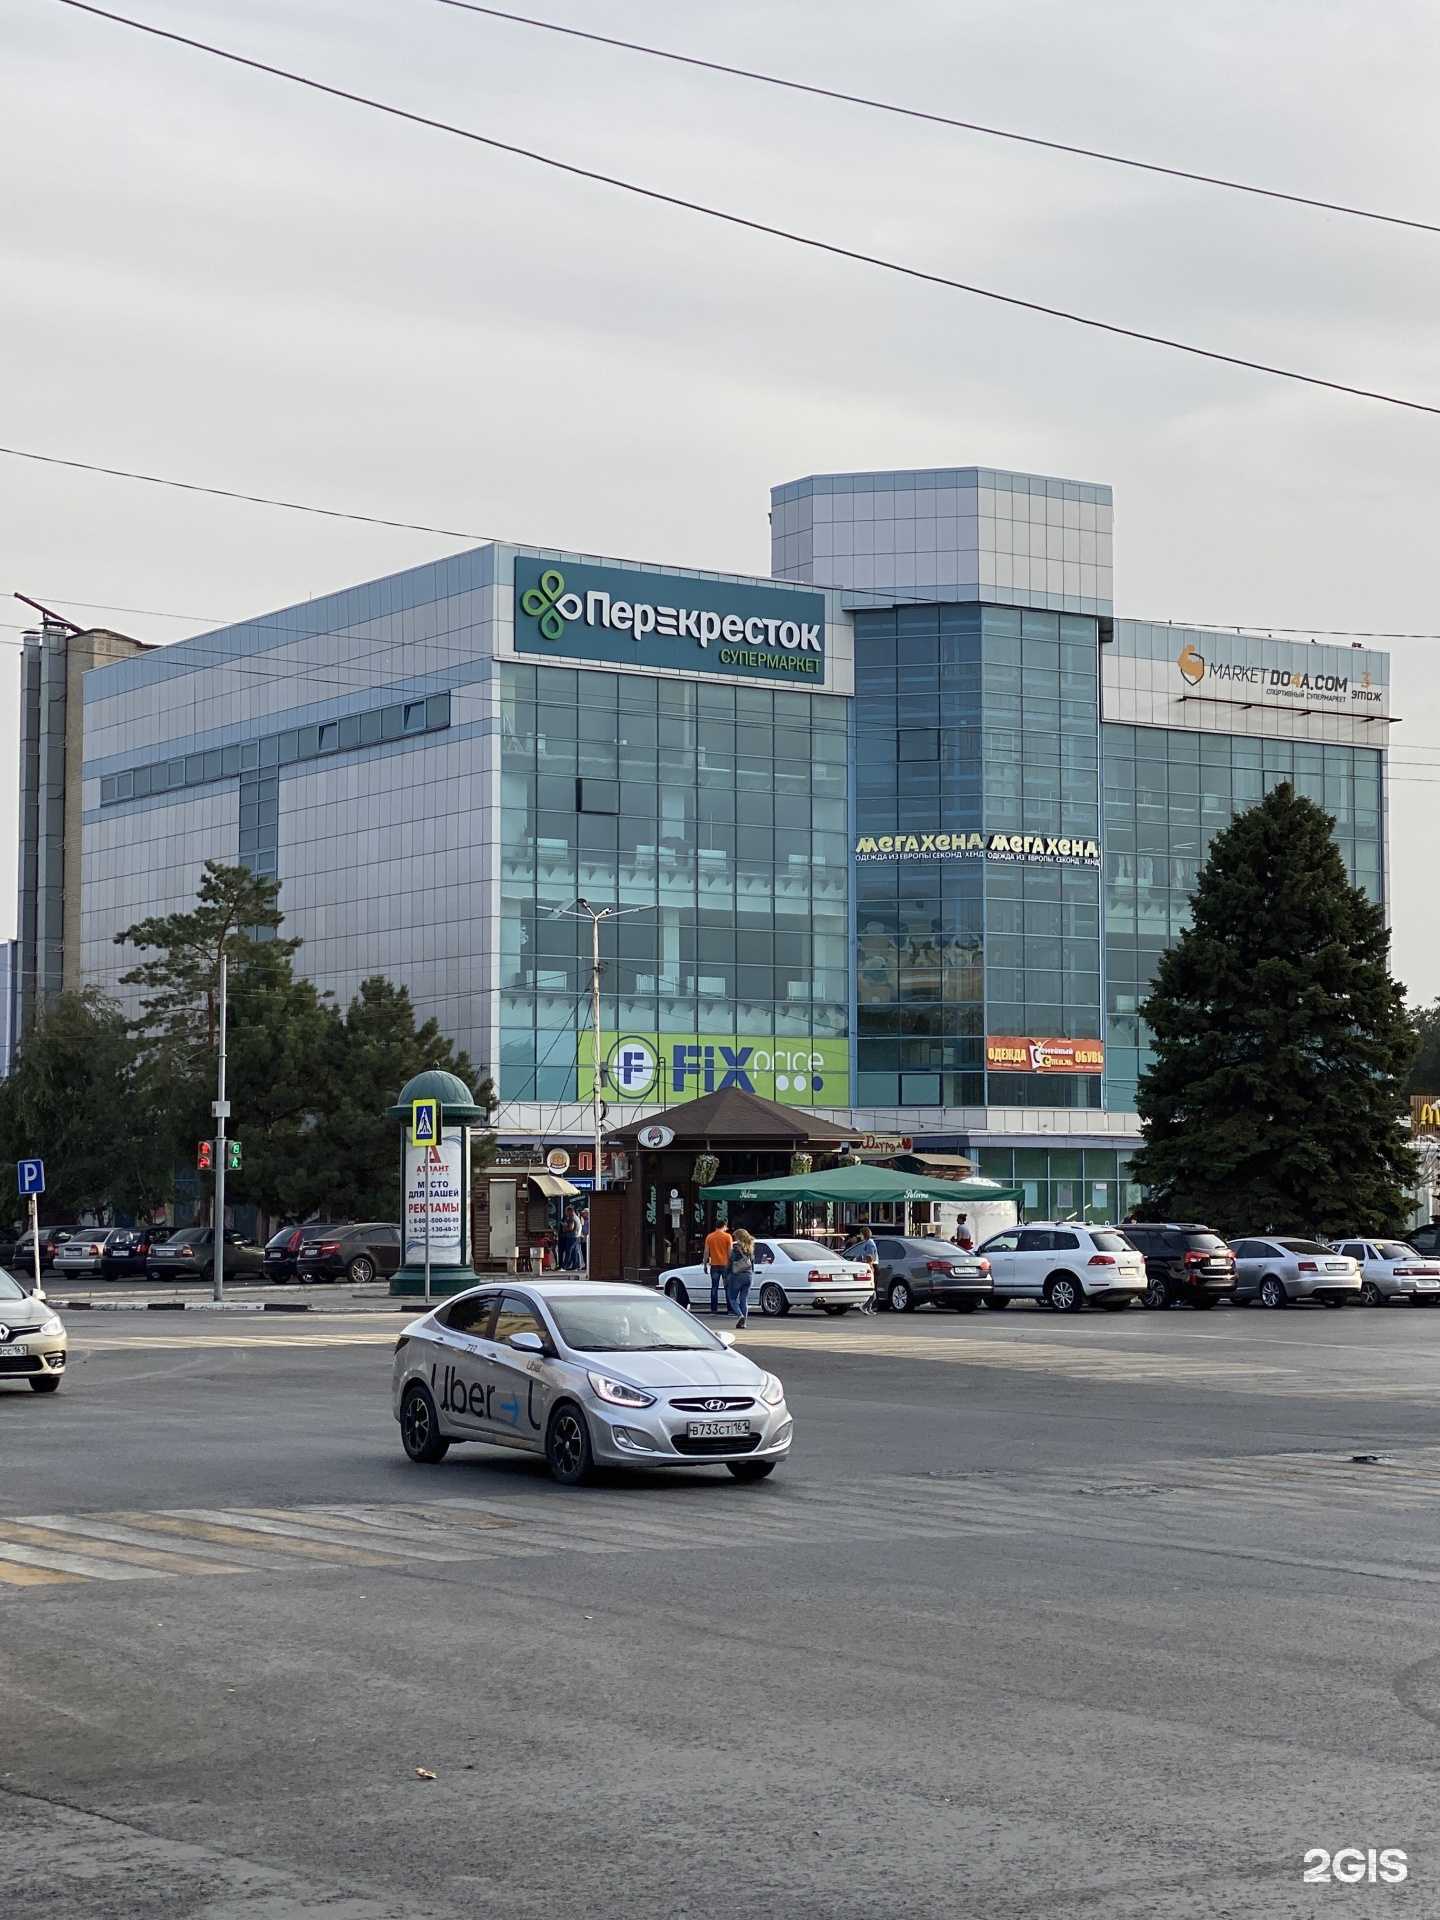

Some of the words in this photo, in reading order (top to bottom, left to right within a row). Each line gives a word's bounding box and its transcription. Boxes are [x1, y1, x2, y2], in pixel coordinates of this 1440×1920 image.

[720, 648, 821, 673] СУПЕРМАРКЕТ
[1361, 671, 1371, 688] 3
[1266, 688, 1305, 698] СПОРТИВНЫЙ
[1306, 693, 1346, 703] СУПЕРМАРКЕТ
[1351, 690, 1382, 702] этаж
[900, 852, 931, 860] ЕВРОПЫ
[932, 851, 962, 859] СЕКОНД
[987, 852, 1014, 860] ОДЕЖДА
[1056, 857, 1079, 865] СЕКОНД
[988, 1048, 1026, 1062] ОДЕЖДА
[1075, 1050, 1103, 1063] ОБУВЬ
[24, 1163, 37, 1190] P
[408, 1190, 425, 1199] ДЛЯ
